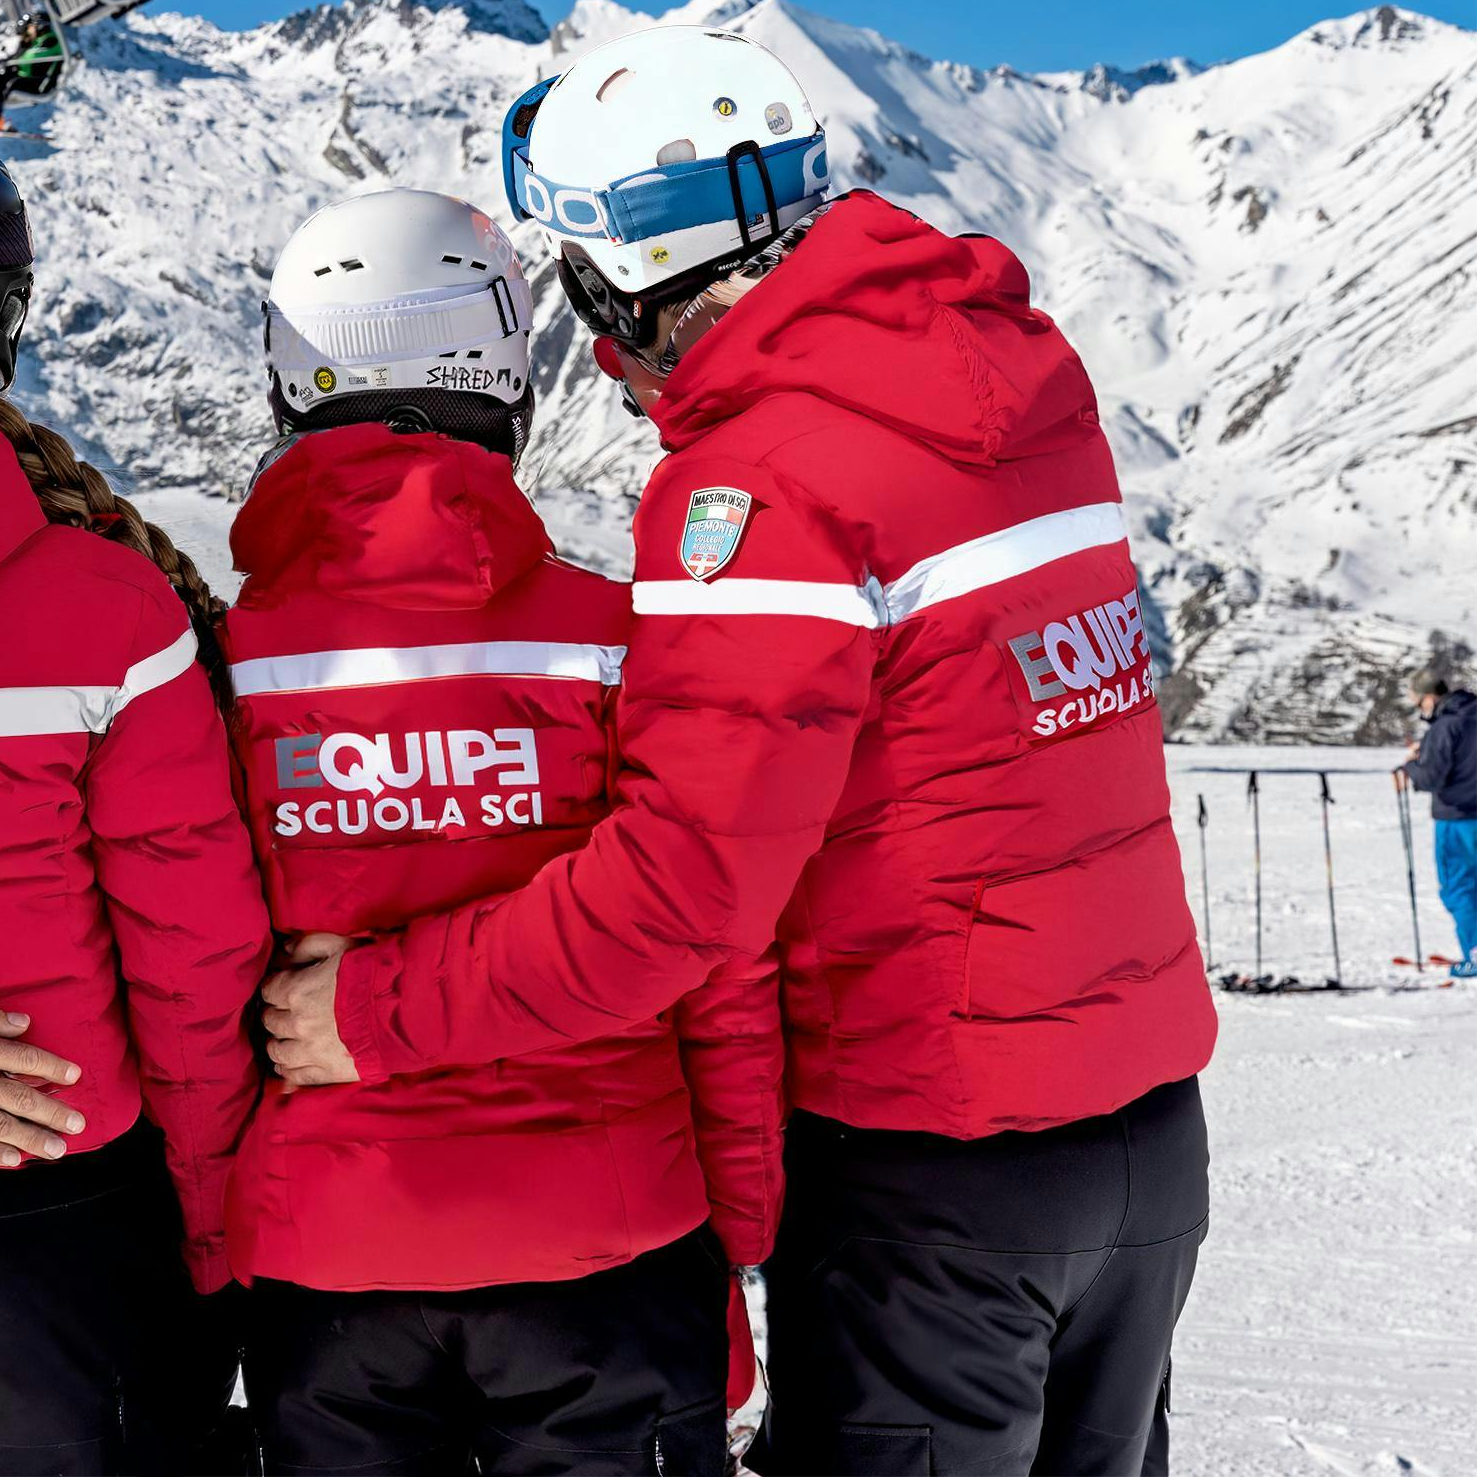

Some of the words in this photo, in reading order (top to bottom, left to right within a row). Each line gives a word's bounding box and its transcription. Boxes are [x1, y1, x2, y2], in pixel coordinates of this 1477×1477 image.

[426, 366, 494, 389] SHRED
[694, 493, 727, 506] MAESTRO
[728, 495, 736, 506] DI
[689, 521, 735, 537] PIEMONTE
[1032, 677, 1140, 737] SCUOLA
[275, 727, 540, 799] EQUIPE
[275, 797, 466, 836] SCUOLA
[480, 791, 543, 827] SCI
